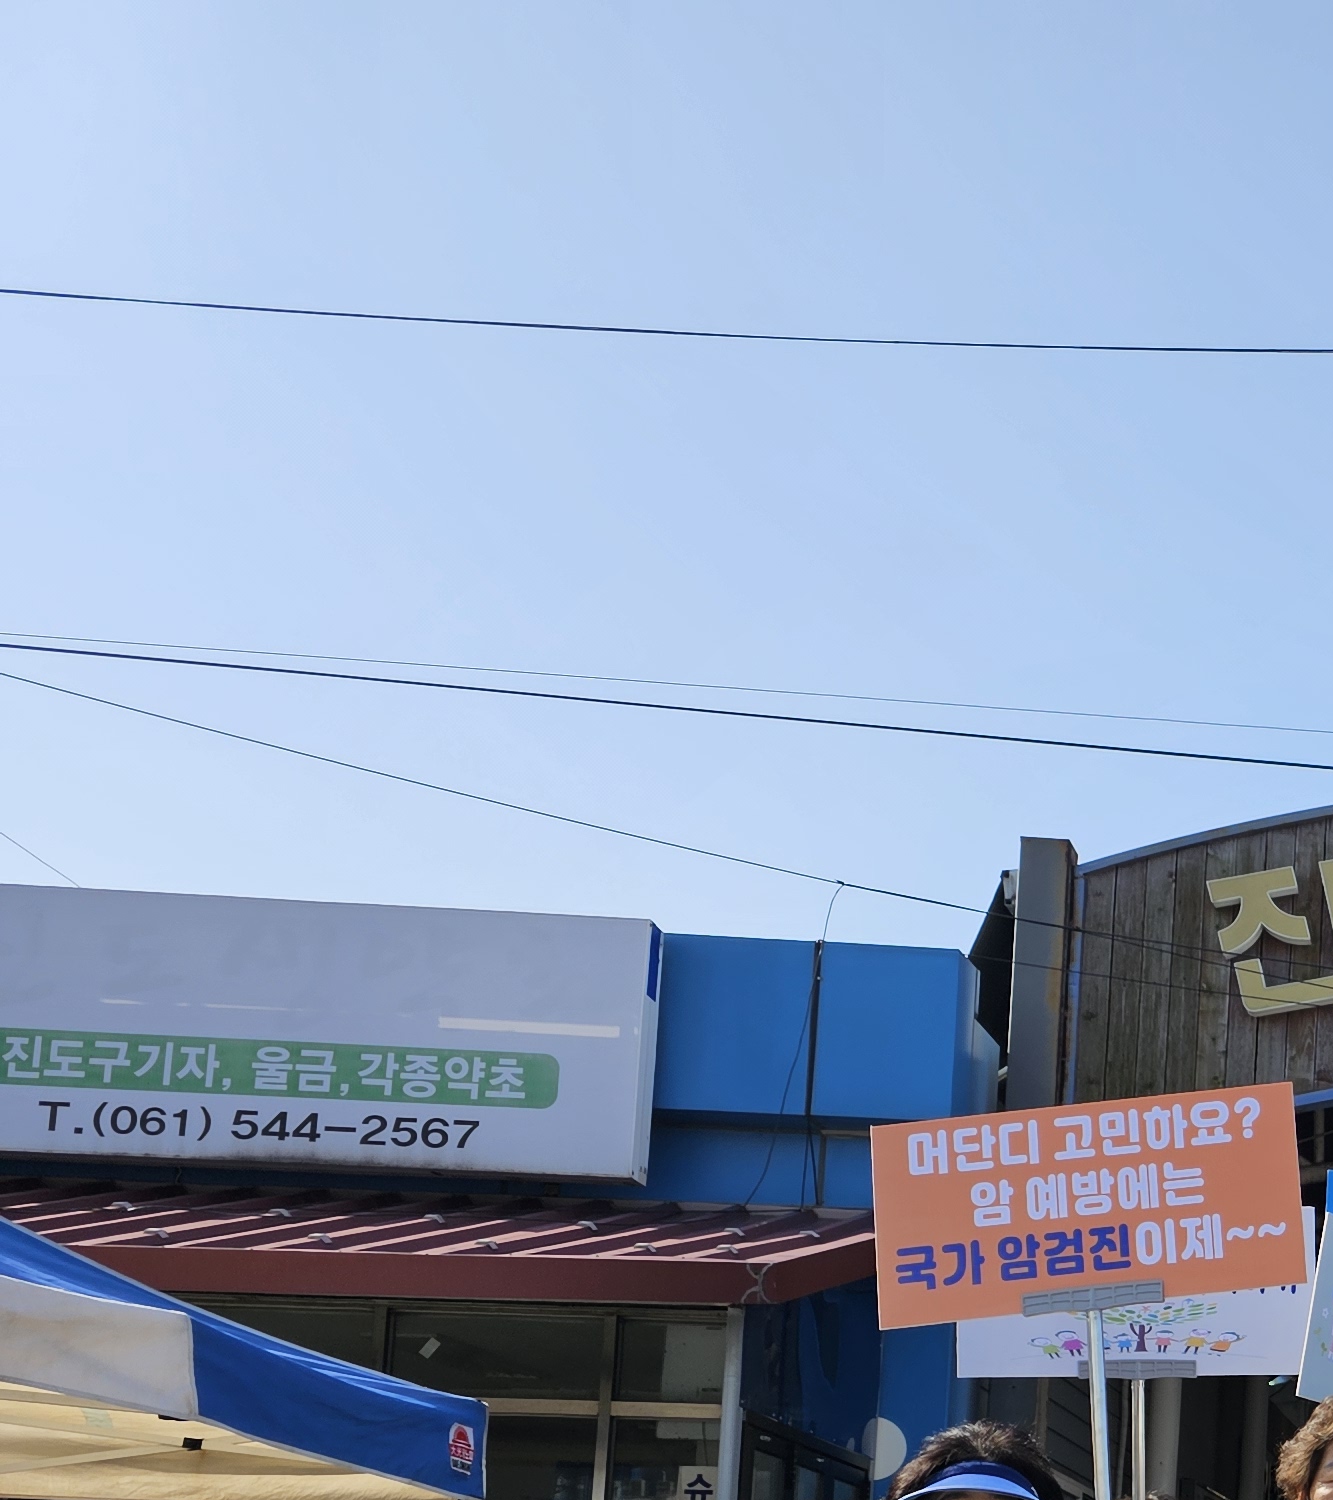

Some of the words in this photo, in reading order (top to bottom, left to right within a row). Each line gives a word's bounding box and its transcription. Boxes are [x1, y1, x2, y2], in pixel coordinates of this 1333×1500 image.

[2, 1035, 232, 1091] 진도구기자,
[38, 1100, 212, 1142] T.(061)
[230, 1111, 480, 1150] 544-2567
[907, 1119, 1039, 1176] 머단디
[1053, 1097, 1260, 1162] 고민하요?
[970, 1179, 1013, 1227] 암
[1026, 1162, 1204, 1220] 예방에는
[895, 1240, 985, 1290] 국가
